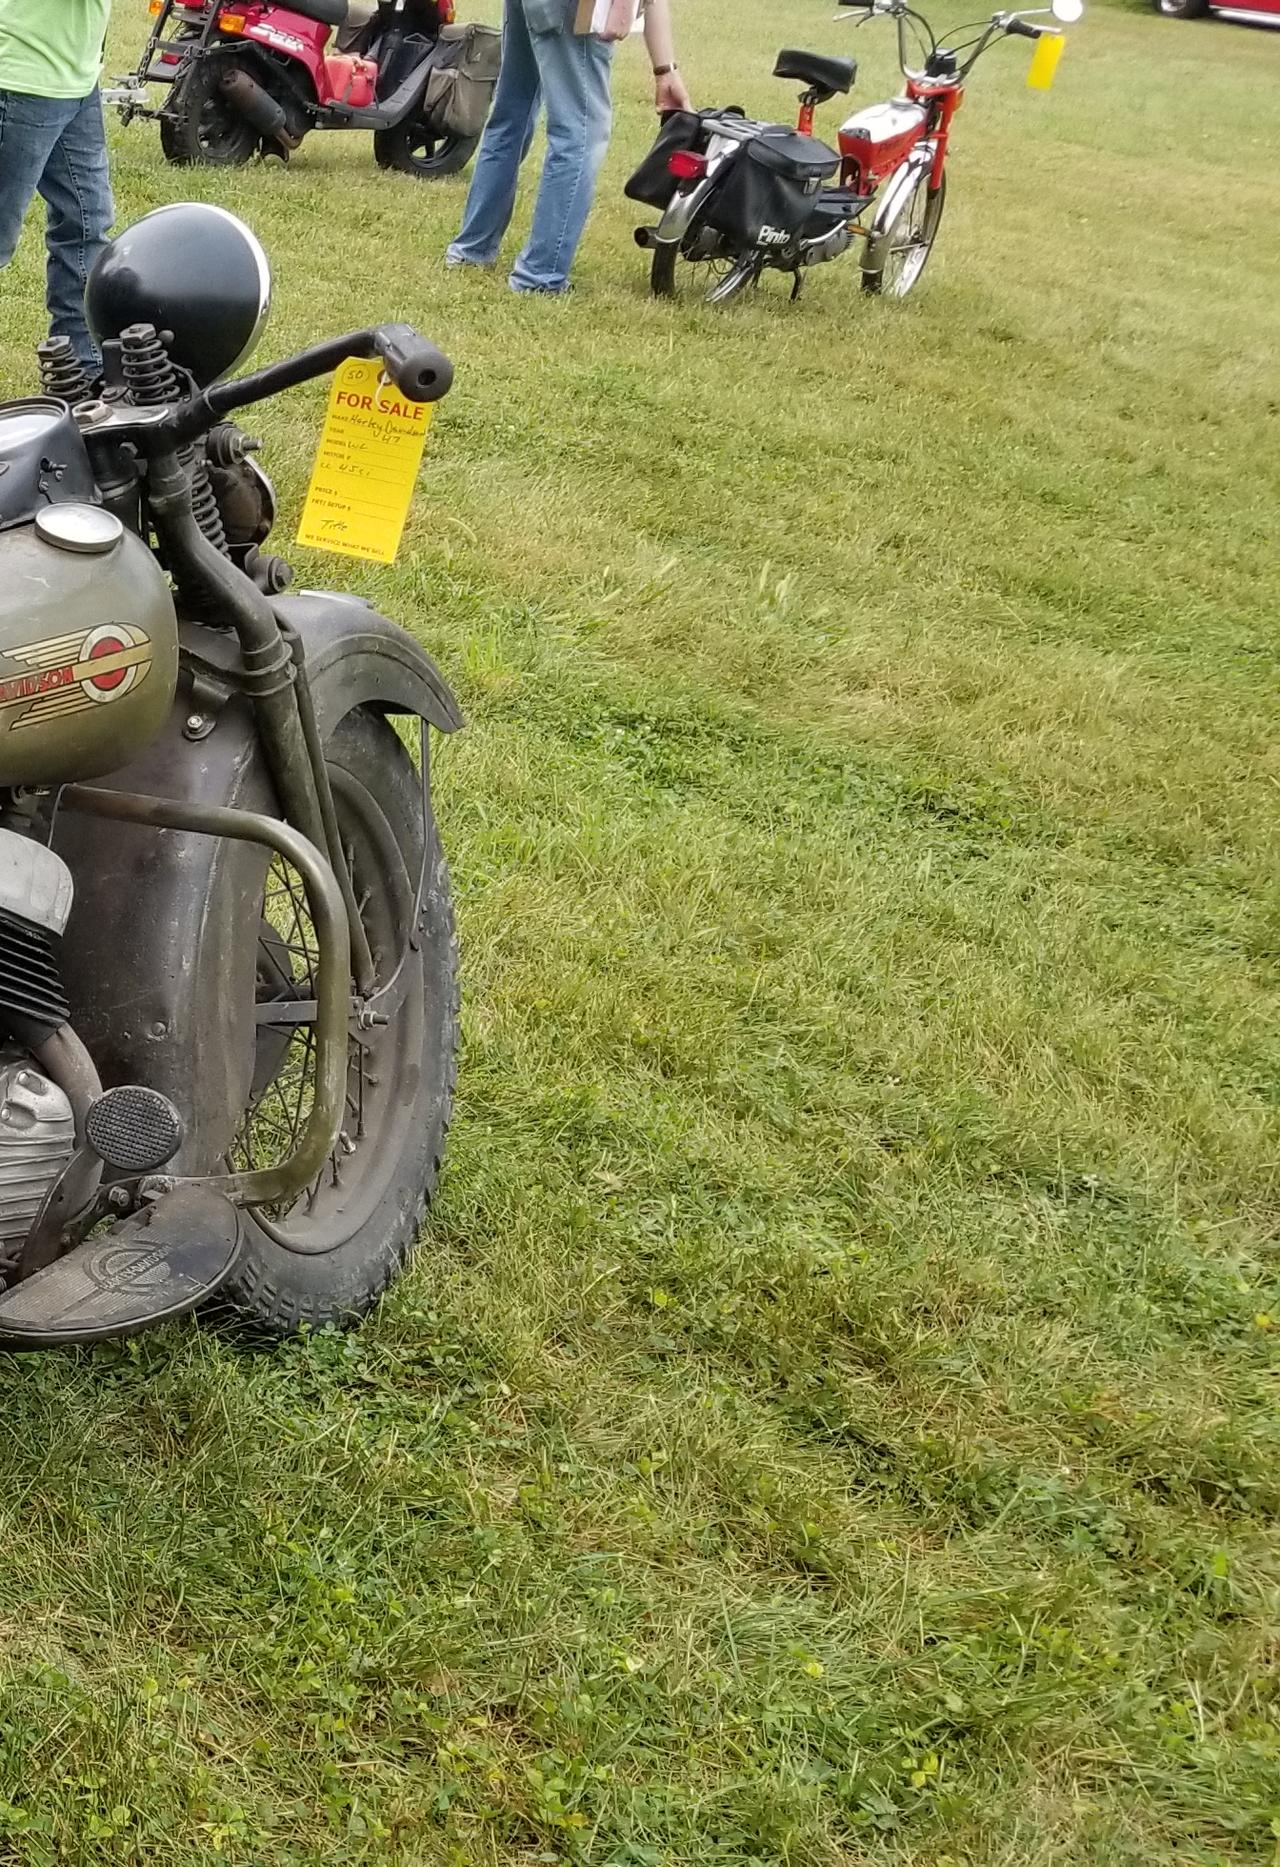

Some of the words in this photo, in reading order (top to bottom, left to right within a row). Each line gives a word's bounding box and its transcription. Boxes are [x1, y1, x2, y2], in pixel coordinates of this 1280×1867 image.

[758, 225, 791, 244] Pinto
[336, 391, 373, 411] FOR
[377, 400, 425, 421] SALE
